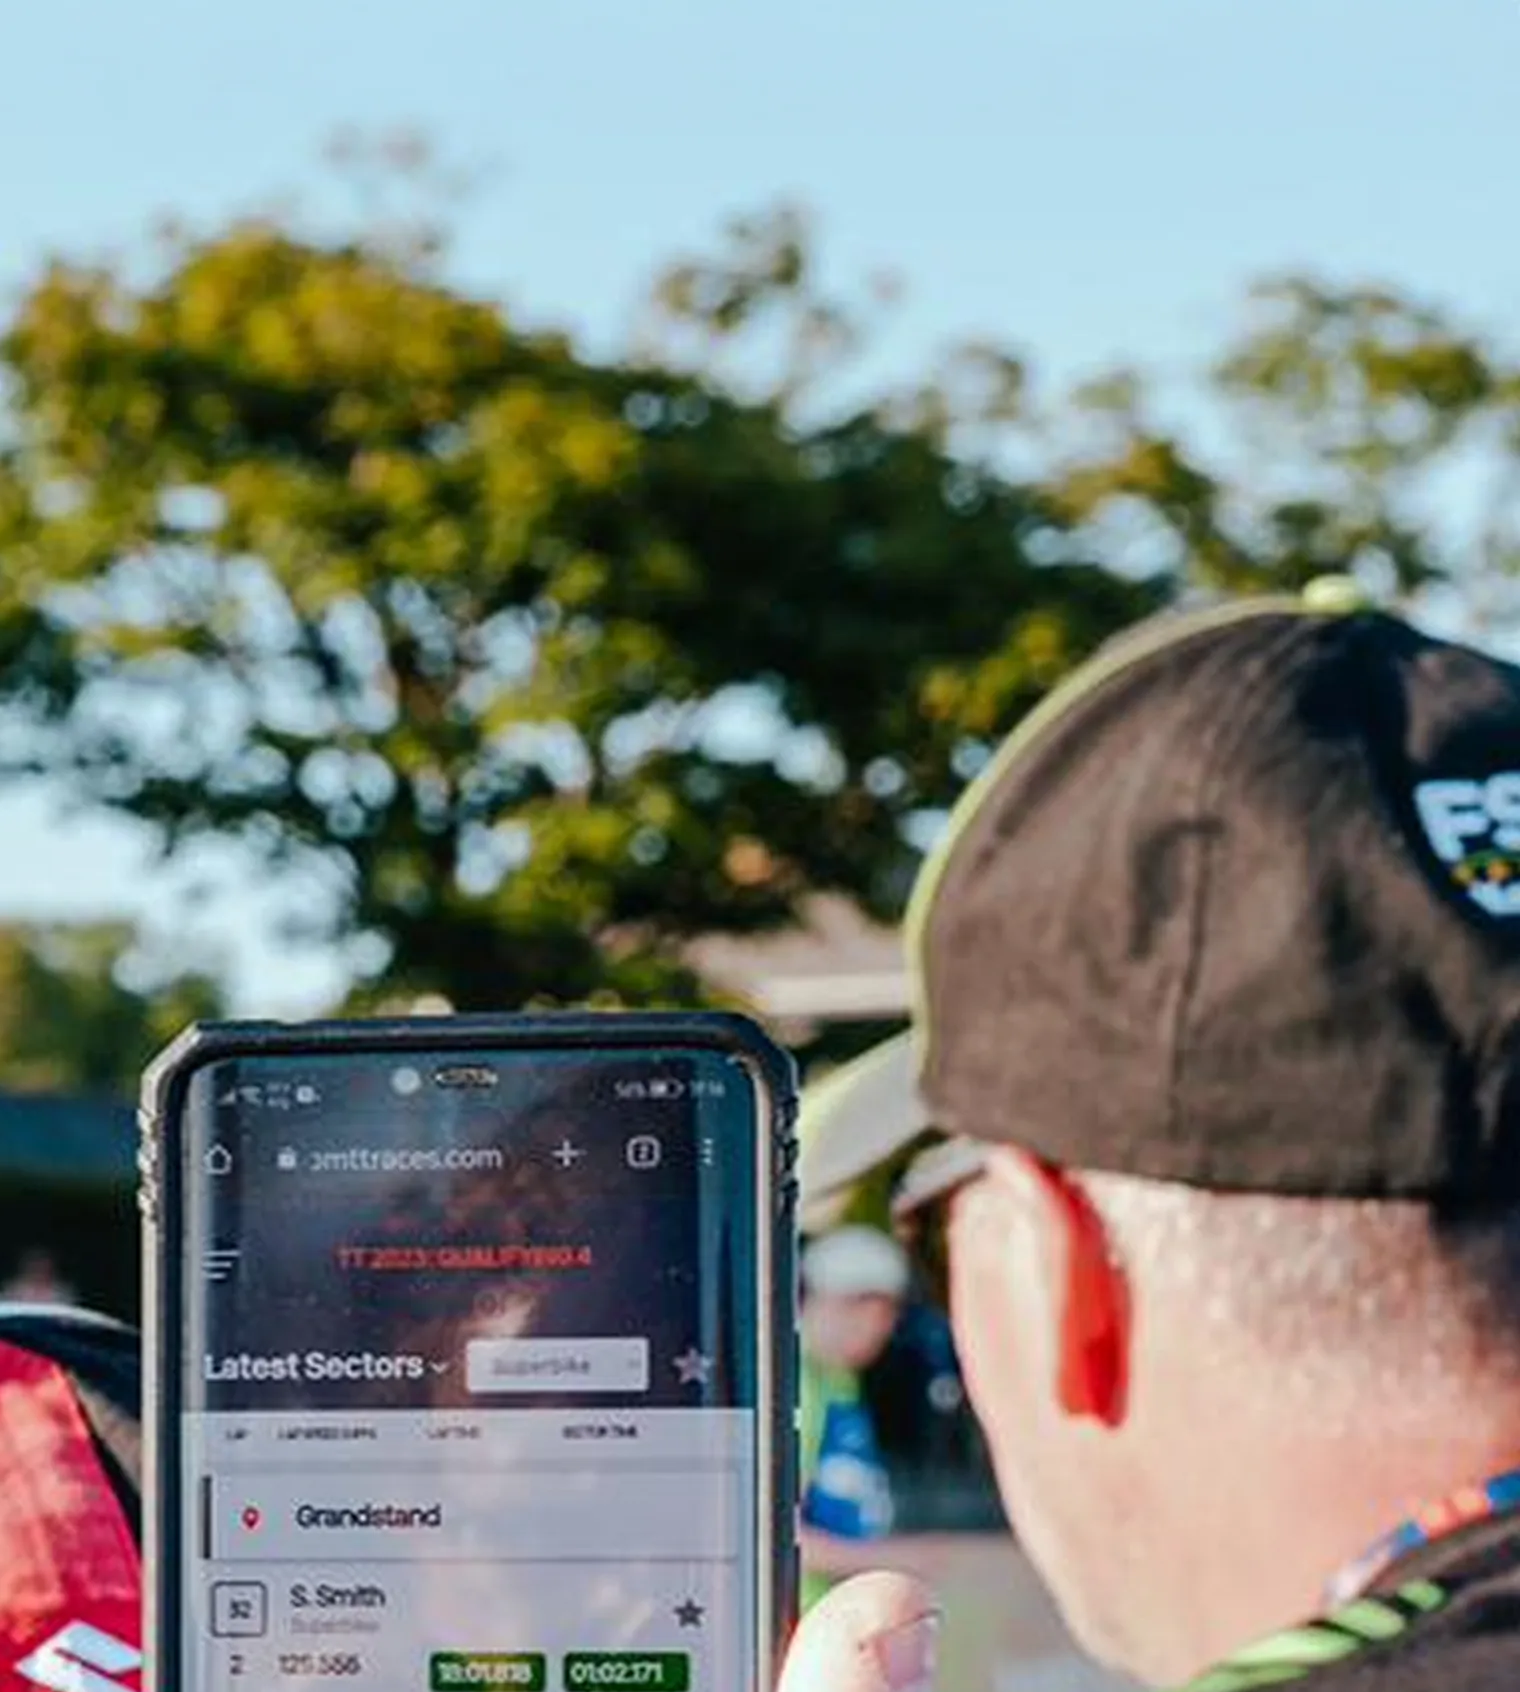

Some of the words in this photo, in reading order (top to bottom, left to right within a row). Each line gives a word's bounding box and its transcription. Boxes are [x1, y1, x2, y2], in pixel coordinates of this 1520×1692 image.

[202, 1351, 301, 1380] Latest
[305, 1350, 426, 1381] Sectors
[296, 1504, 441, 1529] Grandstand
[315, 1584, 387, 1608] Smith
